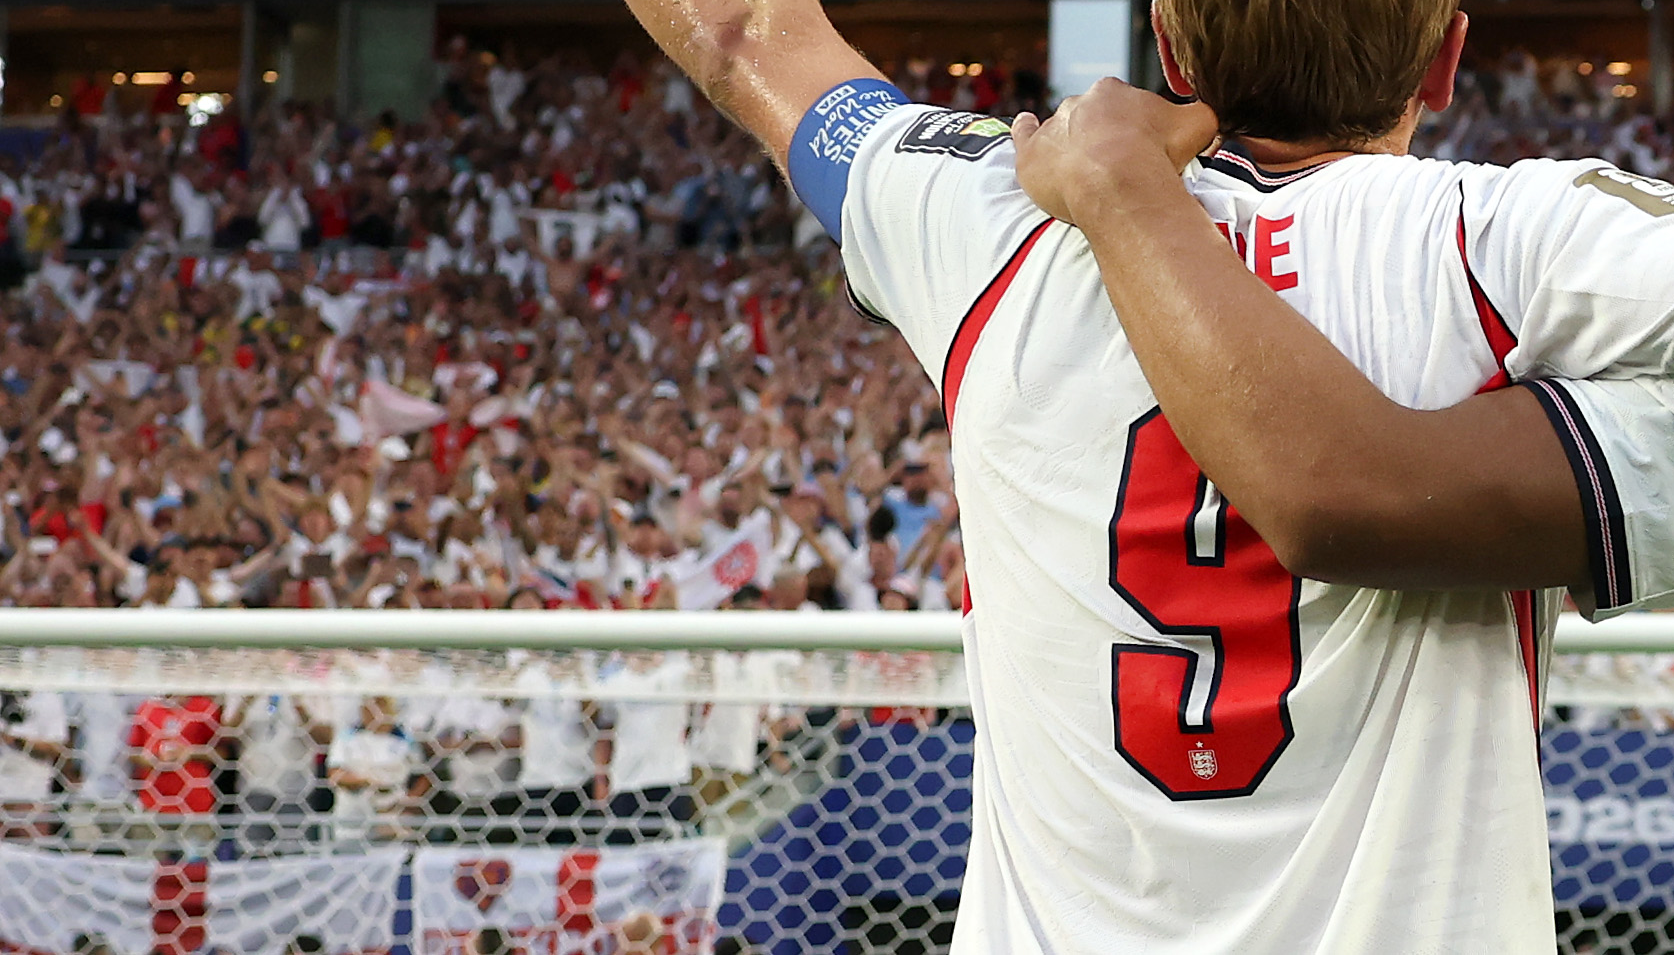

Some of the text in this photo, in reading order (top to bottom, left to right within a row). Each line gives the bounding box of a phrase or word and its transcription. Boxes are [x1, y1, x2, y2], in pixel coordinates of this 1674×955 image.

[808, 98, 864, 158] World
[816, 87, 854, 113] FIFA
[823, 102, 901, 162] UNITES
[1108, 404, 1302, 802] 9
